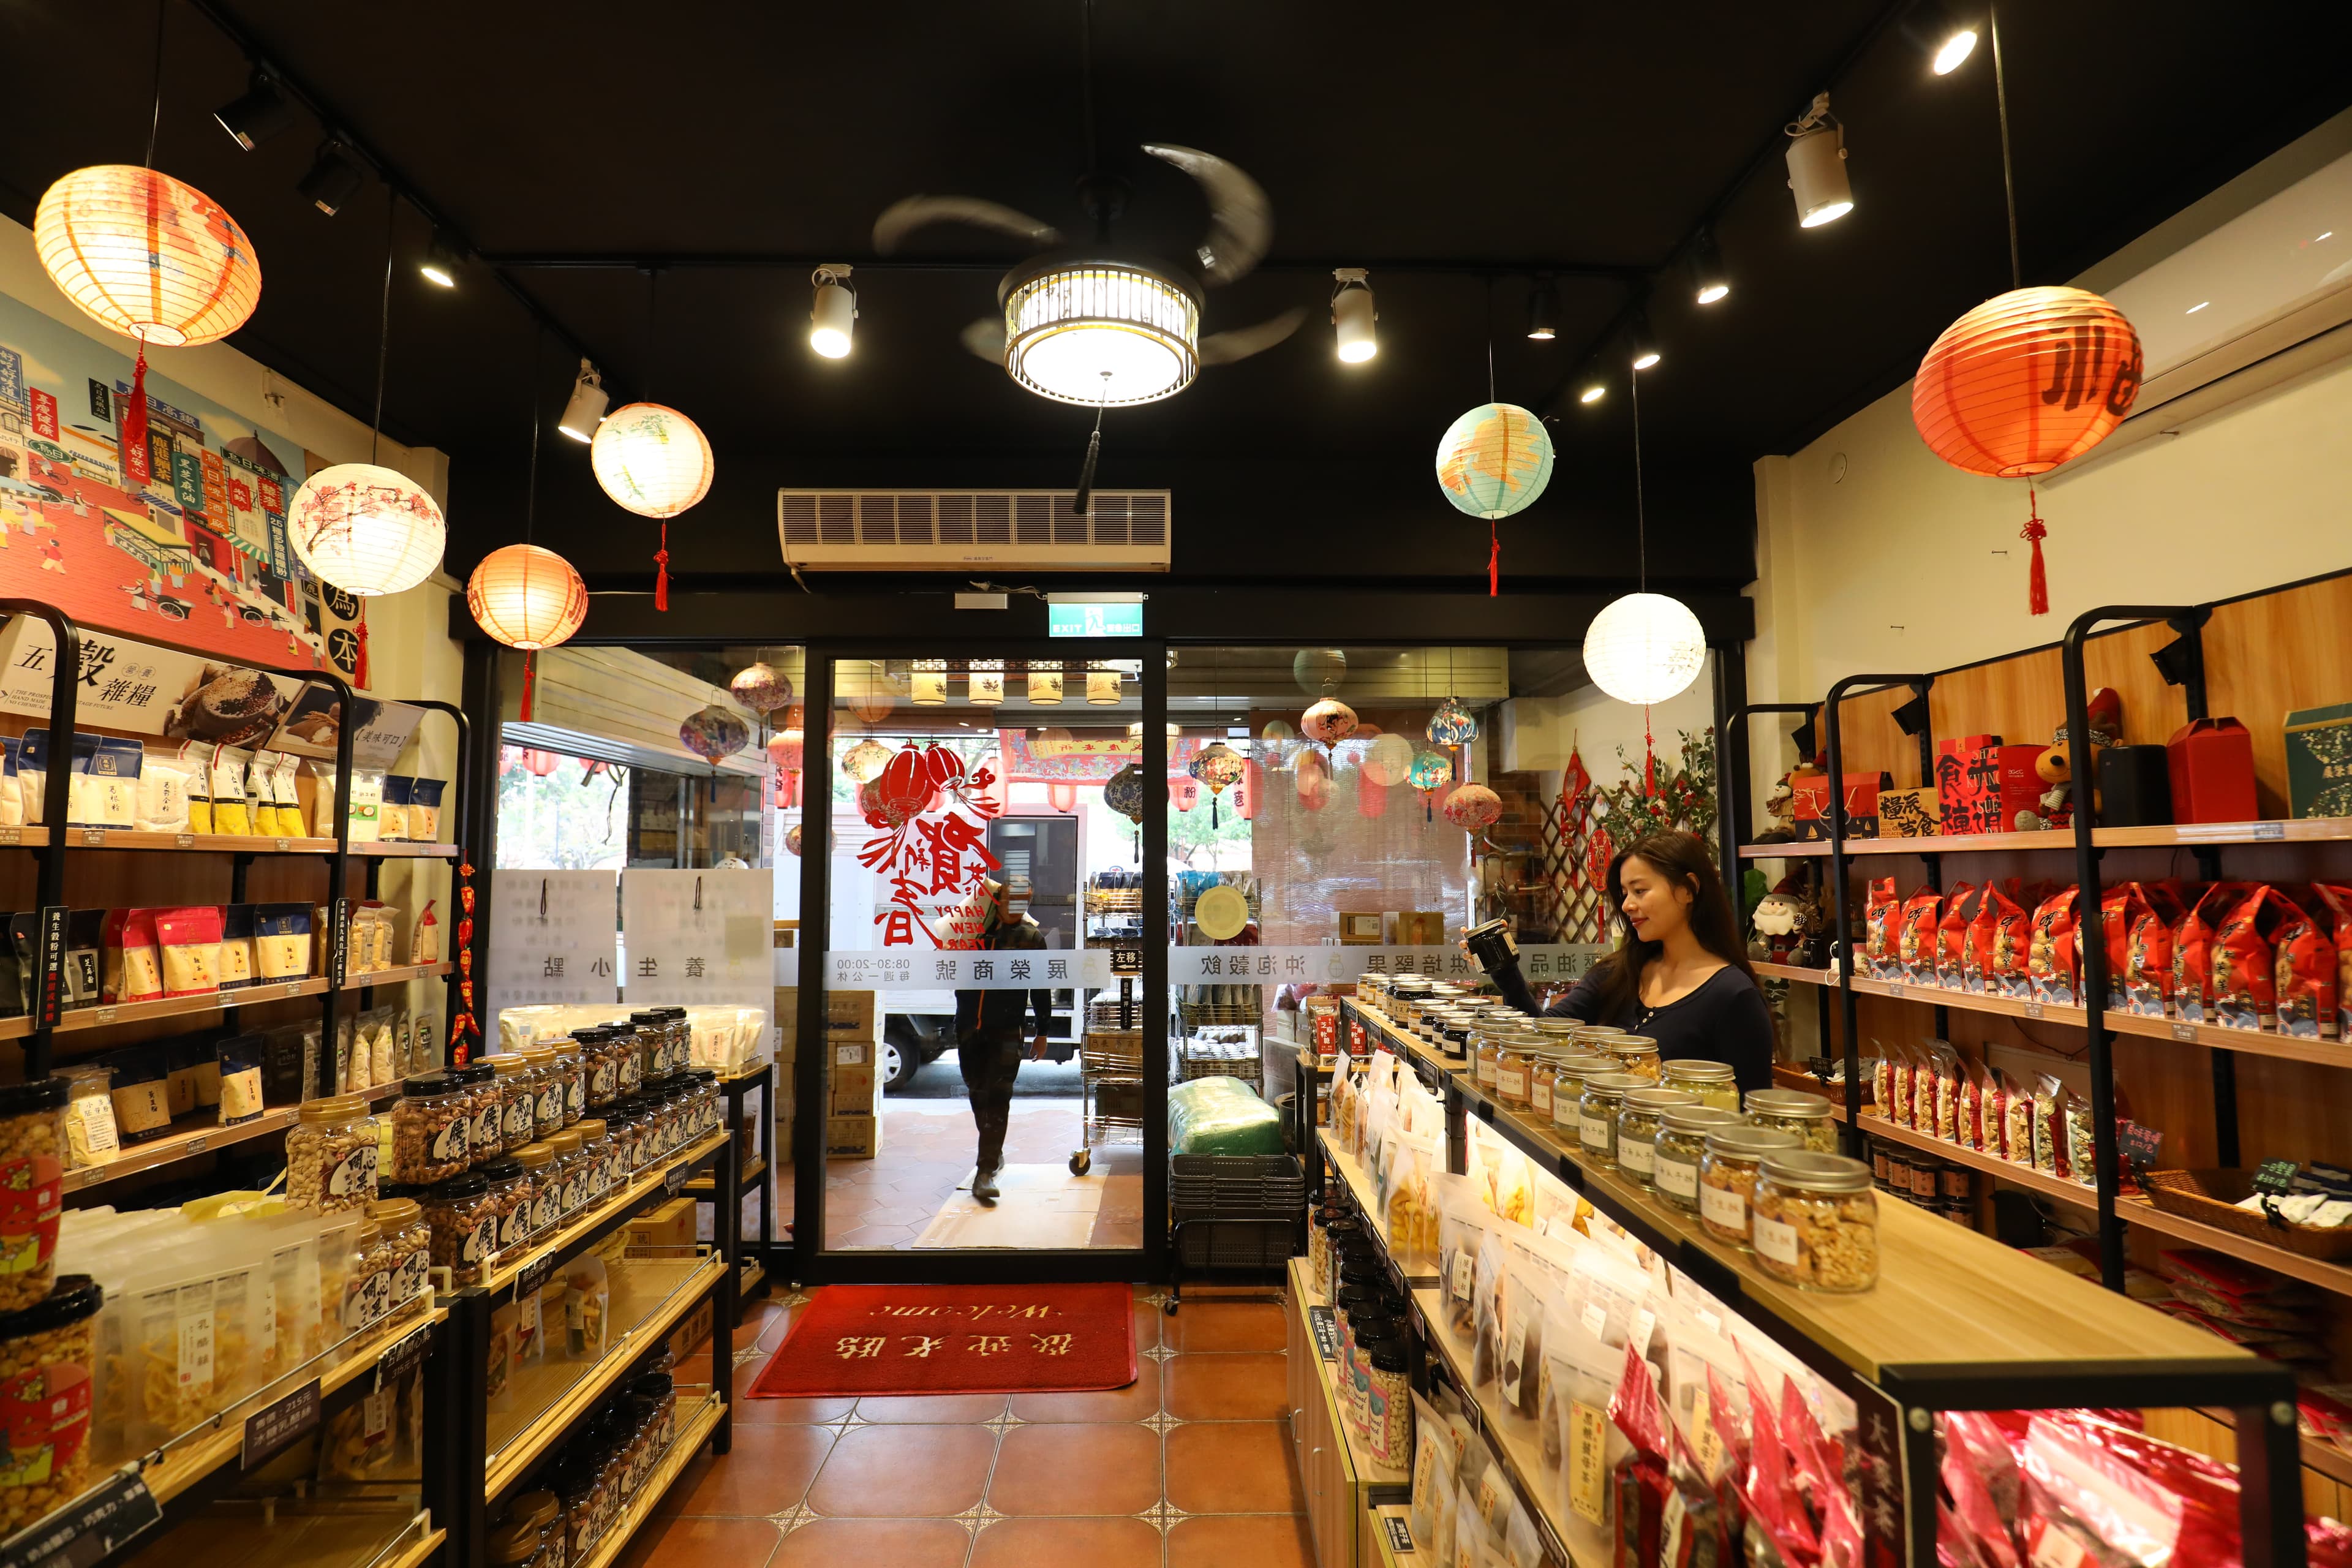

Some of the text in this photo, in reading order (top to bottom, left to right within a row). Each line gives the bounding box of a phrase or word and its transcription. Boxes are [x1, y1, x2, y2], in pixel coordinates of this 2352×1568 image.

[179, 459, 196, 503] 黑芝麻油
[99, 678, 157, 707] 雜糧
[1977, 799, 2000, 814] SUE
[1116, 952, 1136, 963] 左移
[870, 1303, 1061, 1321] Welcome
